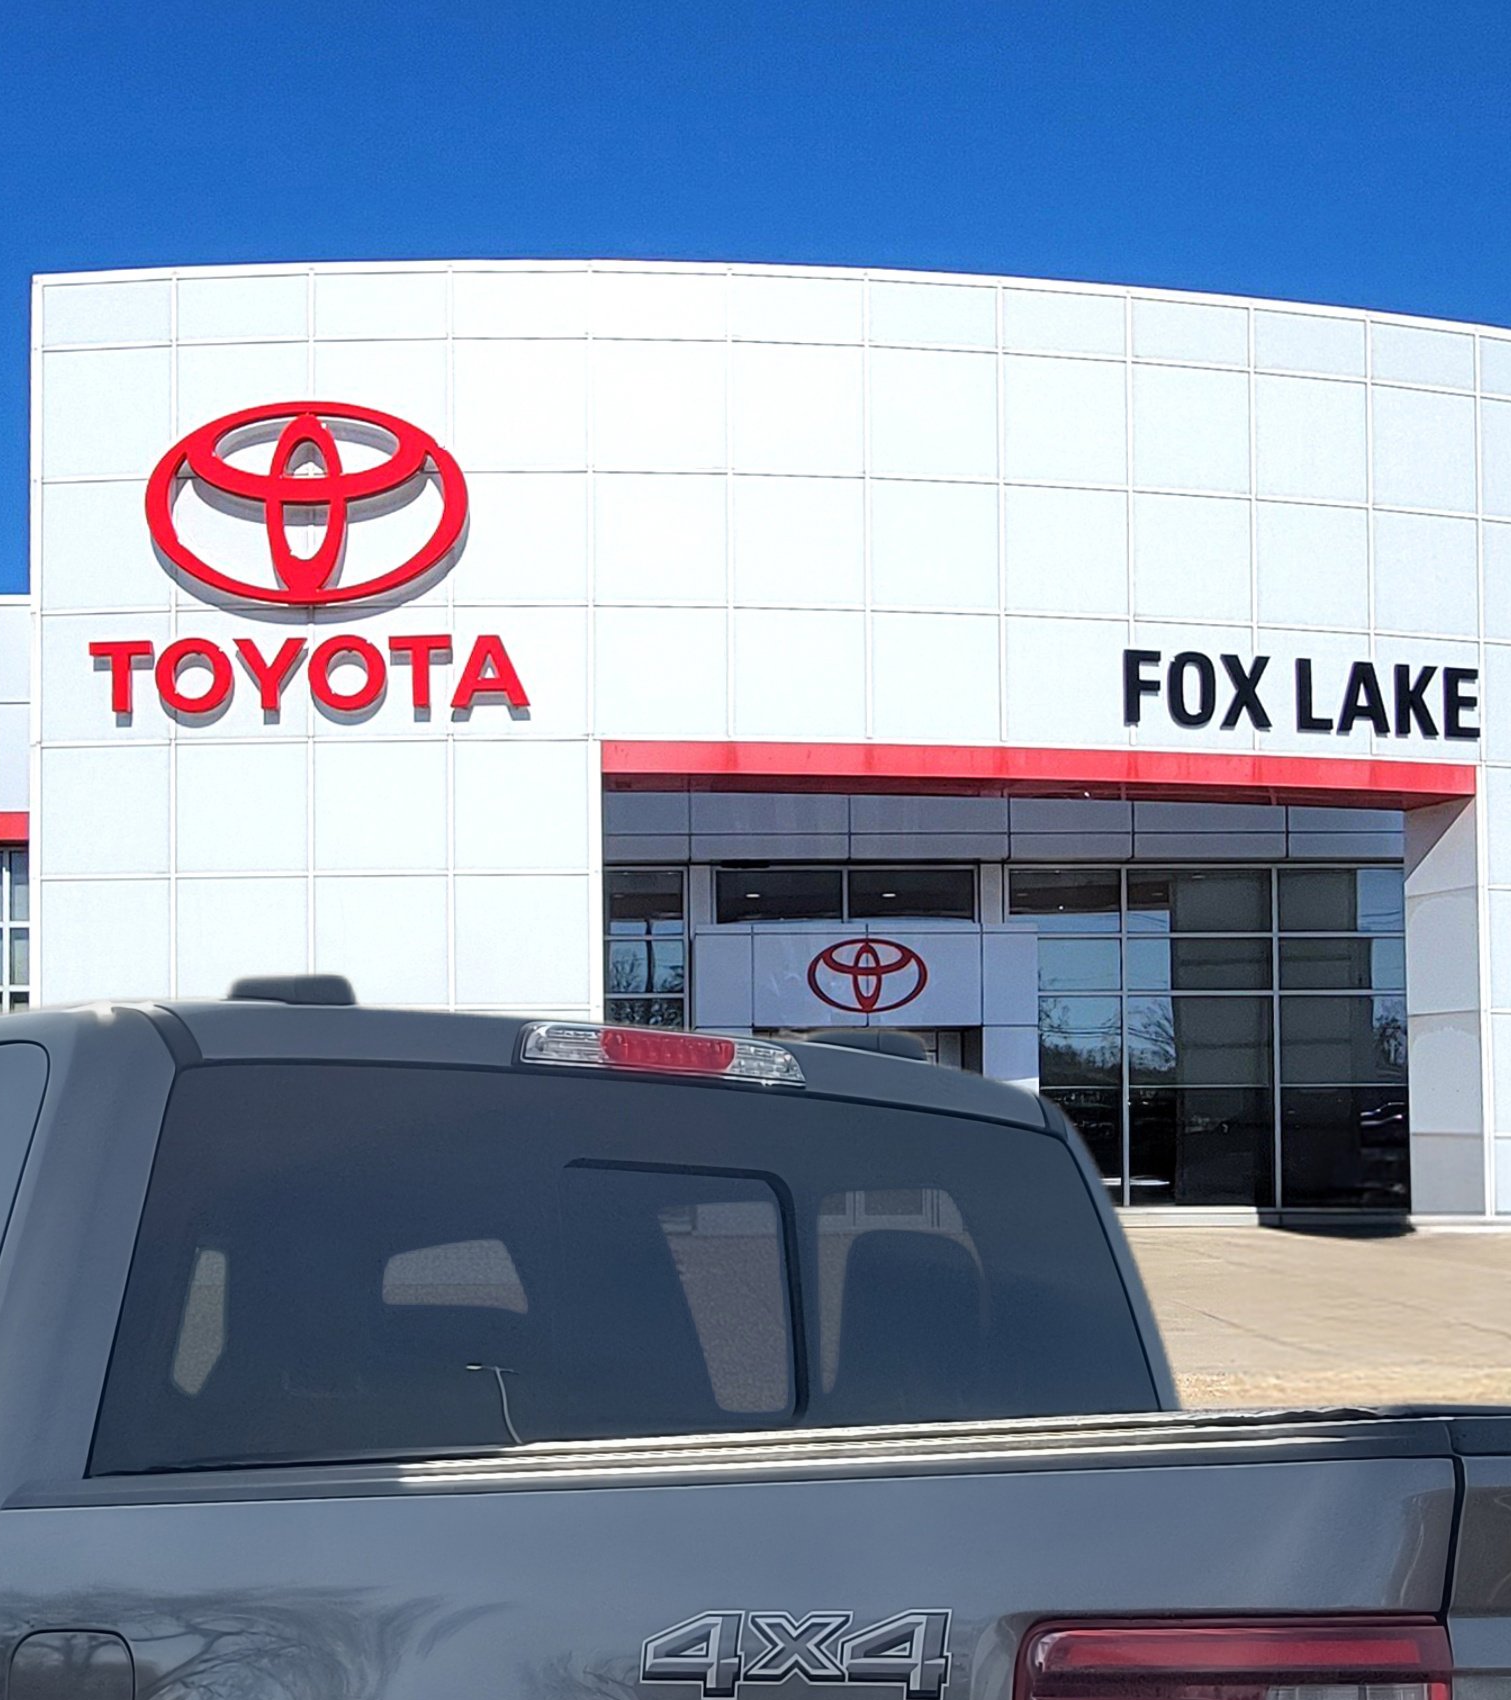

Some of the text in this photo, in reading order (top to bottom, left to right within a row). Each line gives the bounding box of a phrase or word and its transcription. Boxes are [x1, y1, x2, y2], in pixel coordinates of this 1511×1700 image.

[89, 634, 531, 725] TOYOTA
[1122, 649, 1481, 740] FOX LAKE
